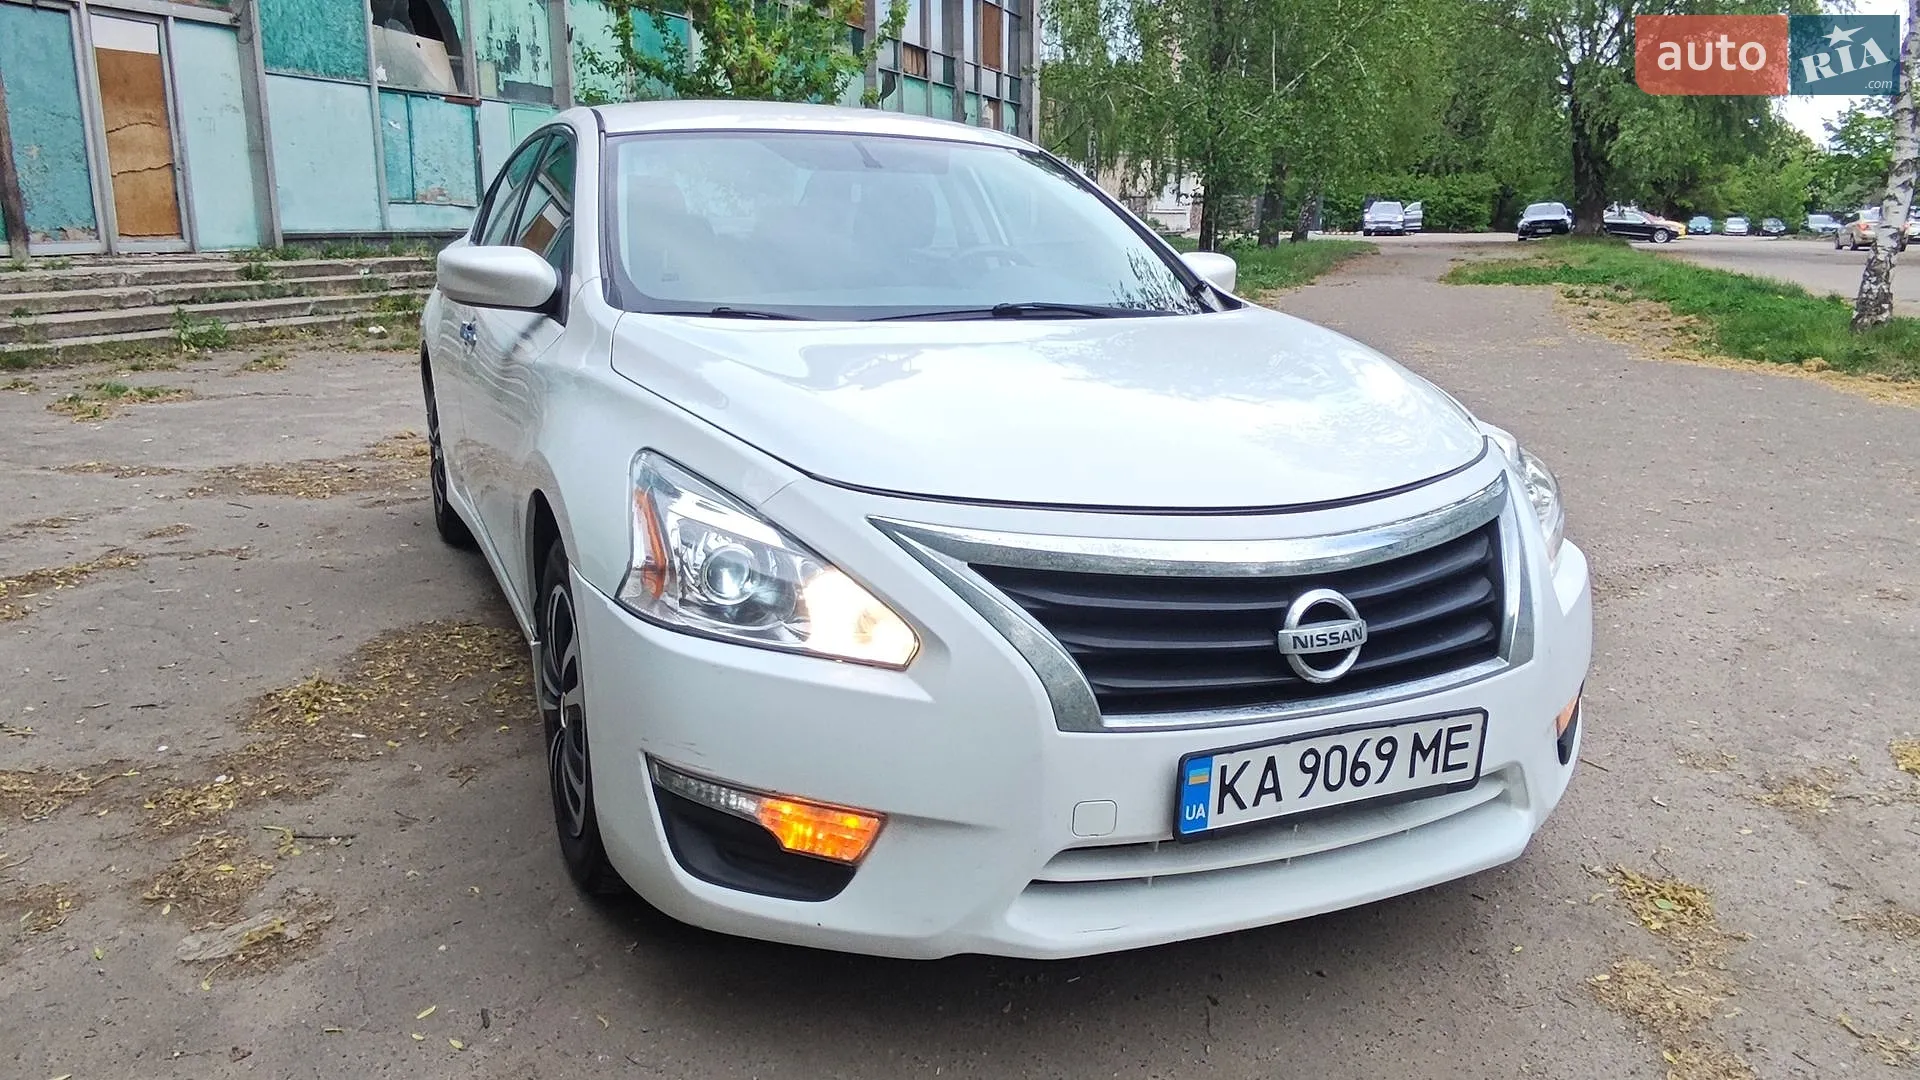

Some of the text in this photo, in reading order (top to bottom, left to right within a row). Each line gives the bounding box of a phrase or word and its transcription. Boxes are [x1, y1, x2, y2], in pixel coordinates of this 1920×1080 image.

[1292, 626, 1362, 649] NISSAN
[1217, 723, 1472, 814] KA 9069 ME
[1185, 804, 1206, 821] UA
